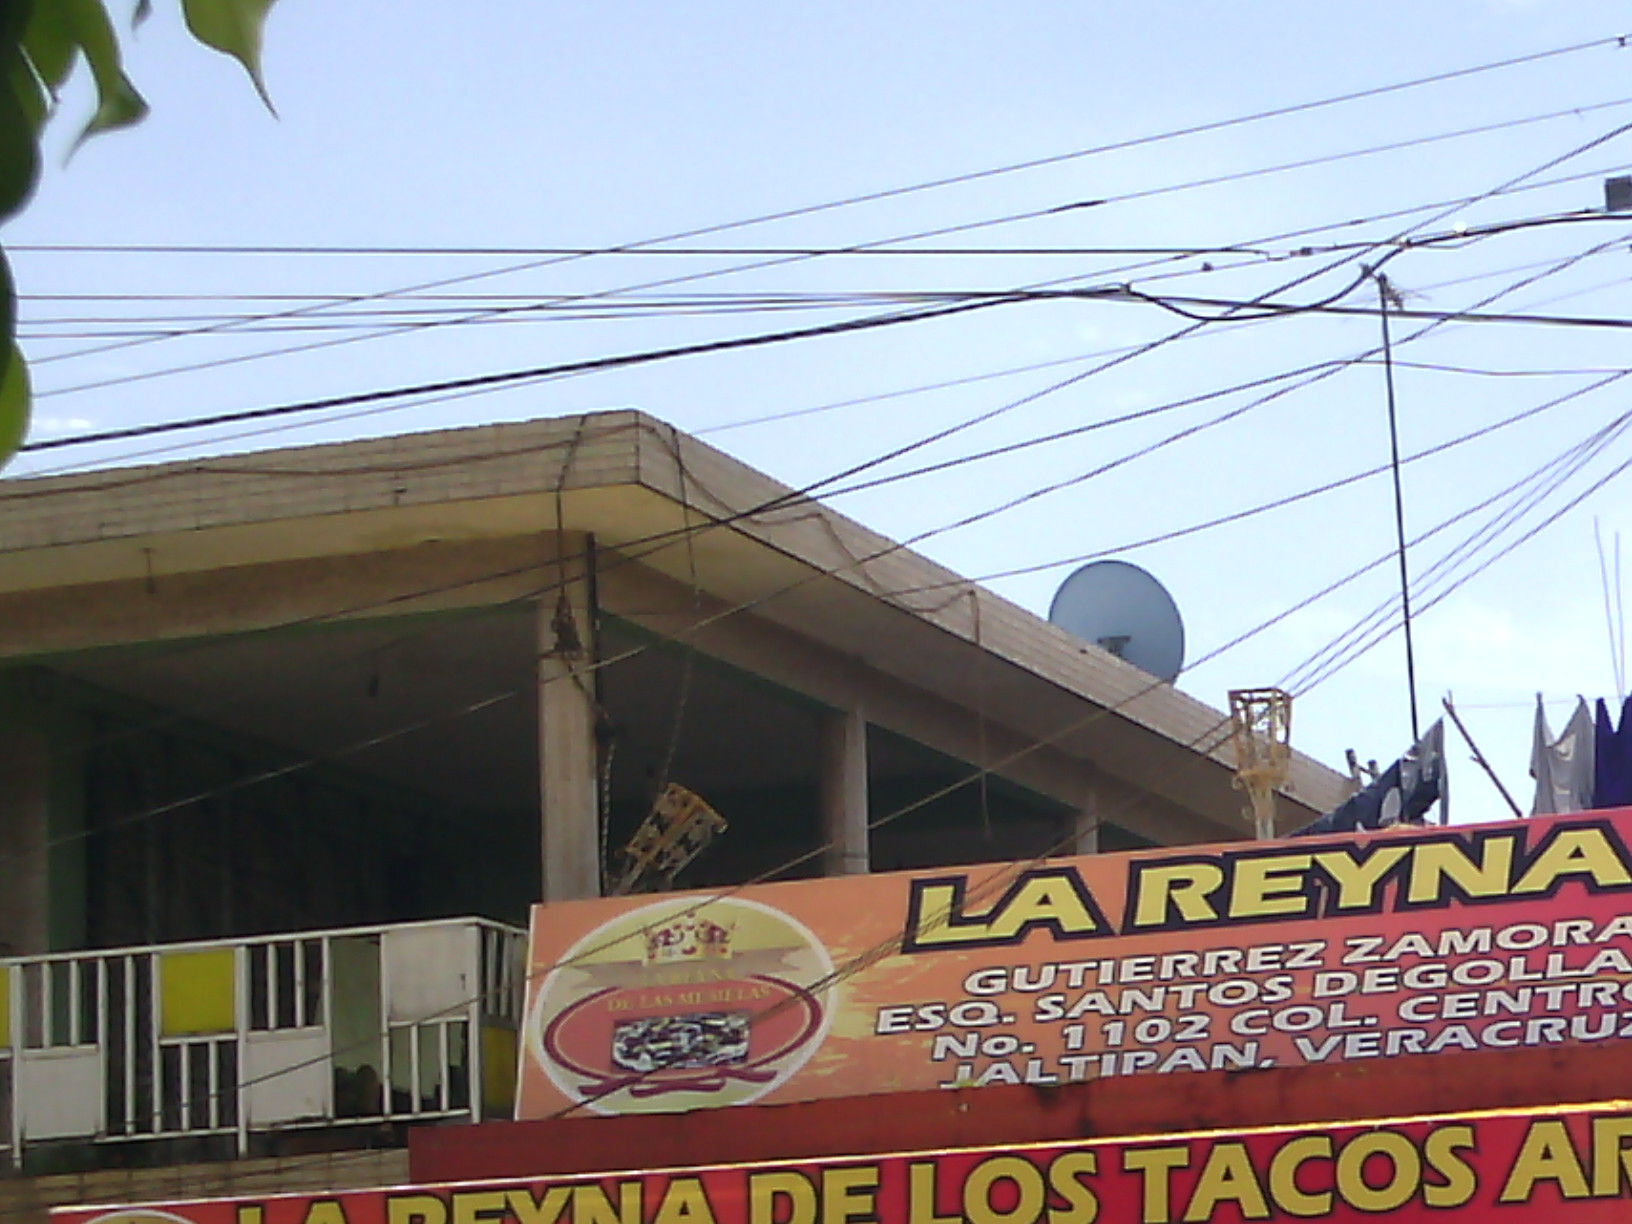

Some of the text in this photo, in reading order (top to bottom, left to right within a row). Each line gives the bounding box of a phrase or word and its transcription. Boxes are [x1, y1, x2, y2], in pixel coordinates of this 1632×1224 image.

[909, 864, 1108, 949] LA
[964, 940, 1327, 995] GUTIERREZ
[876, 1002, 1015, 1034] ESQ.
[1035, 975, 1292, 1022] SANTOS
[933, 1033, 1034, 1060] No.
[1063, 1014, 1210, 1049] 1102
[1230, 1003, 1378, 1035] COL.
